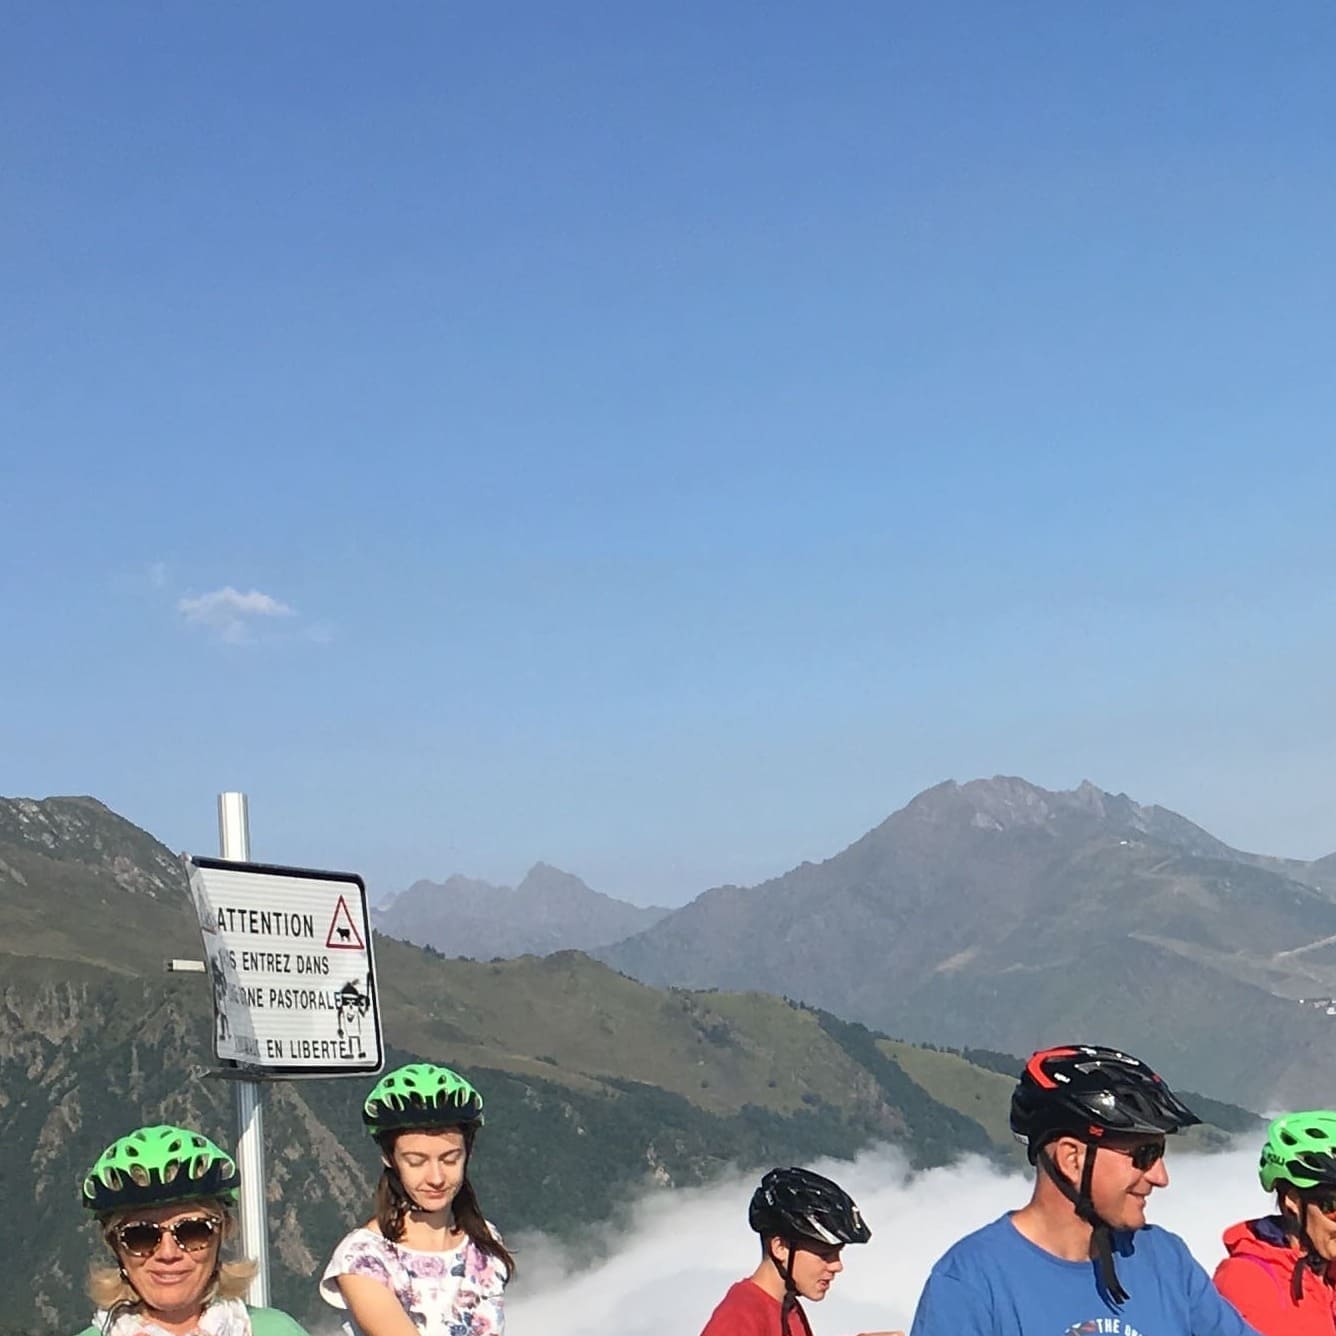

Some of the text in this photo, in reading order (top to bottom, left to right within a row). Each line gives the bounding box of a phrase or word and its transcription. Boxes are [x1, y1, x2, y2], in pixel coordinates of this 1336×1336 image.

[217, 907, 314, 938] ATTENTION
[242, 951, 290, 973] ENTREZ
[297, 955, 329, 975] DANS
[269, 988, 342, 1010] PASTORALE
[266, 1039, 283, 1058] EN
[1096, 1318, 1120, 1333] THE
